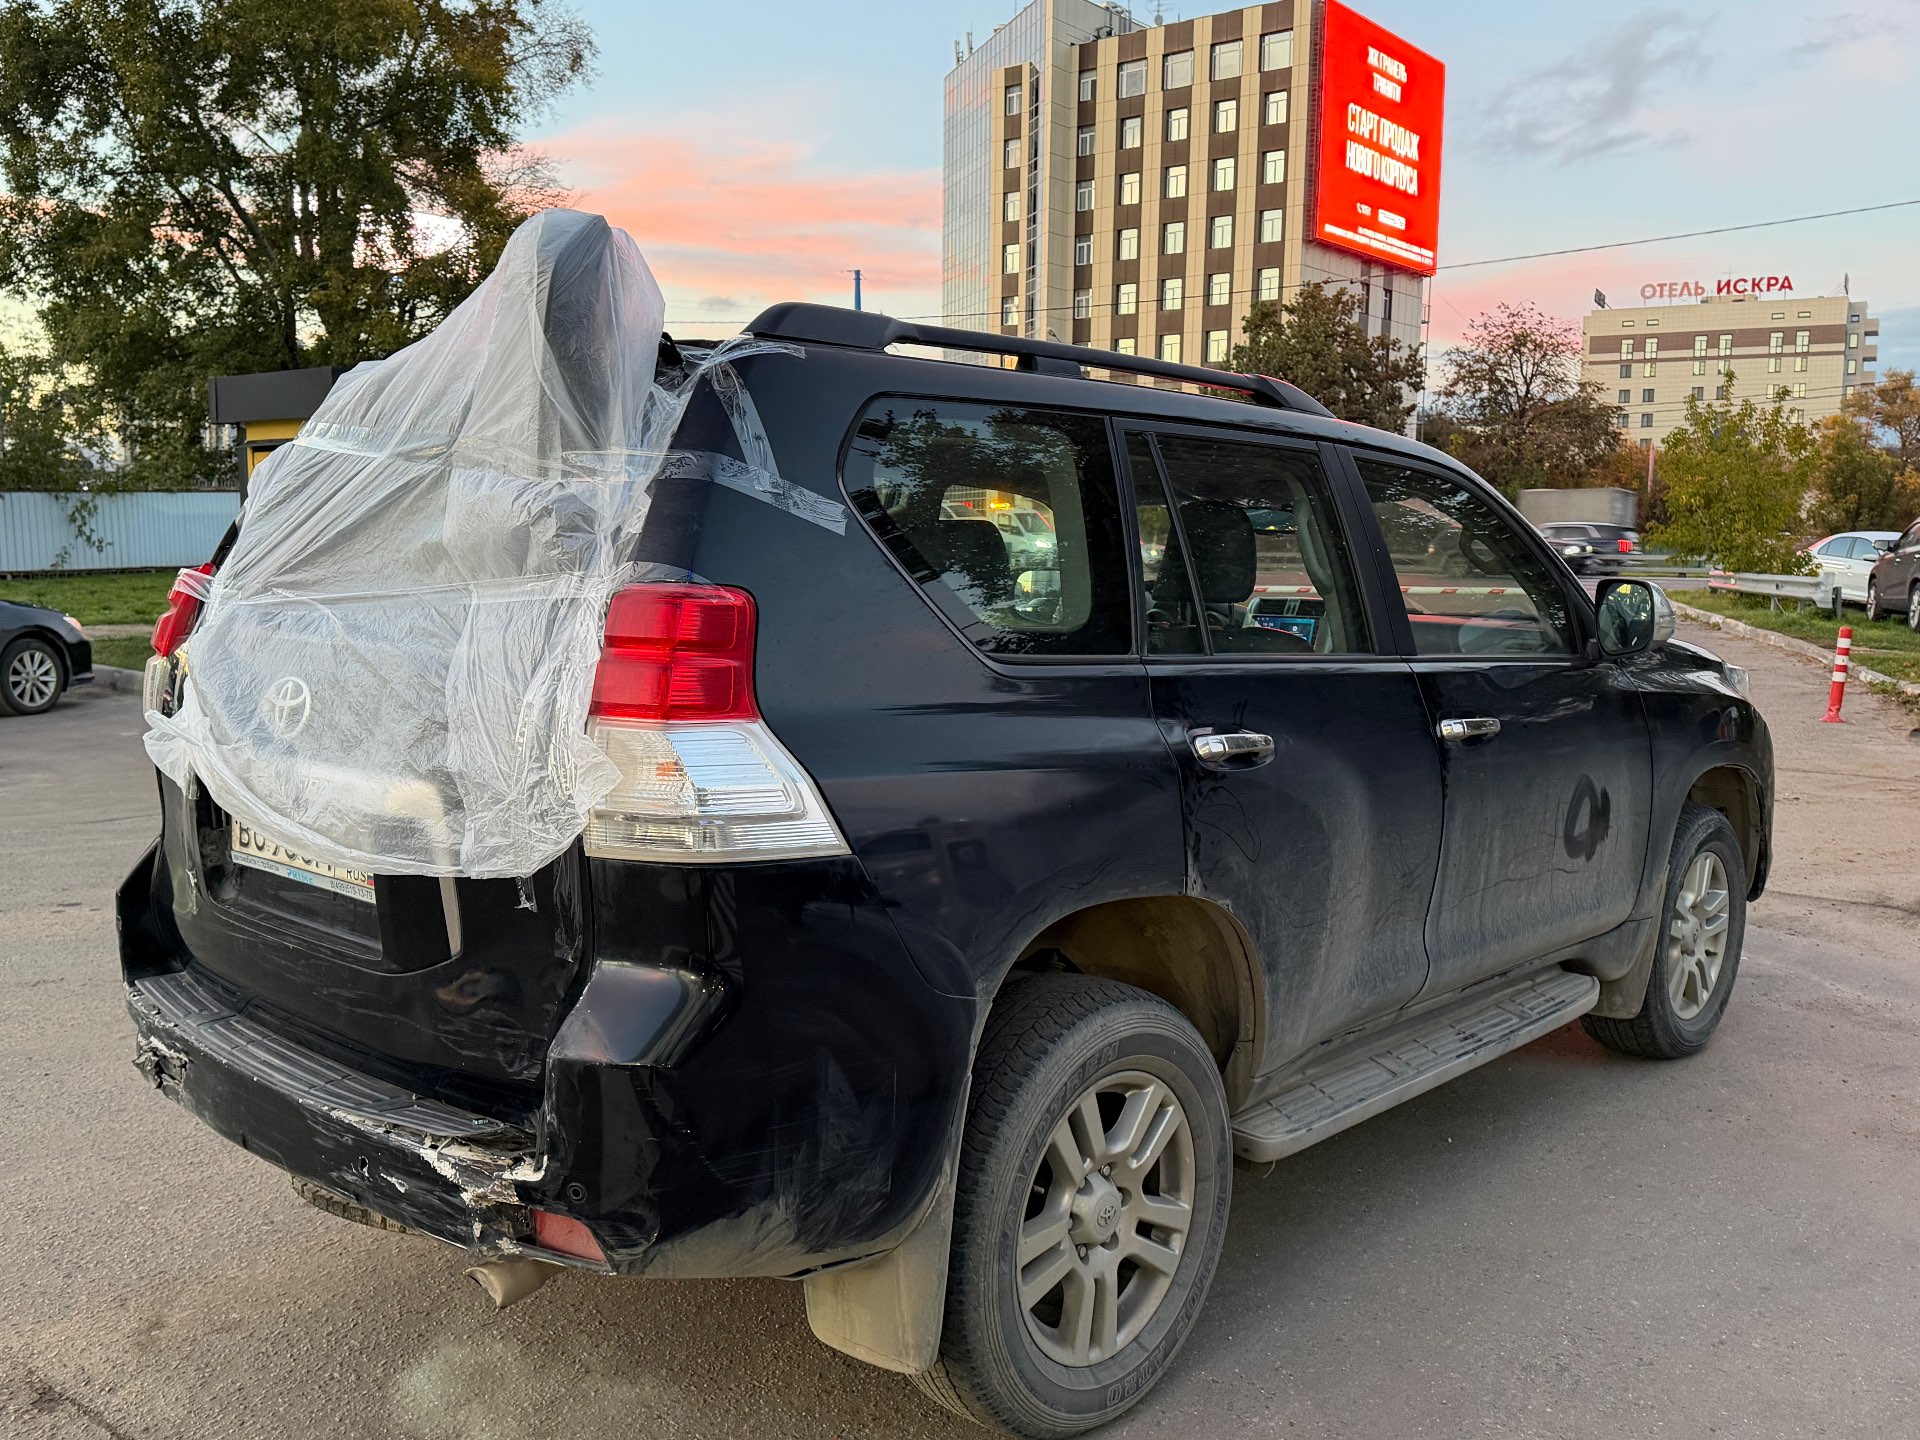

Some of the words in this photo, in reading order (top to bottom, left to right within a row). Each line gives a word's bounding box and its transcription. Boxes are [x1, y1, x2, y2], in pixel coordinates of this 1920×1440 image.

[1347, 102, 1380, 143] СТАРТ
[1379, 117, 1420, 162] ПРОДАЖ
[1345, 139, 1381, 180] НОВОГО
[1380, 154, 1419, 196] КОРПУСА
[1640, 281, 1706, 300] ОТЕЛЬ
[1716, 275, 1794, 295] ИСКРА
[346, 868, 367, 883] RUS
